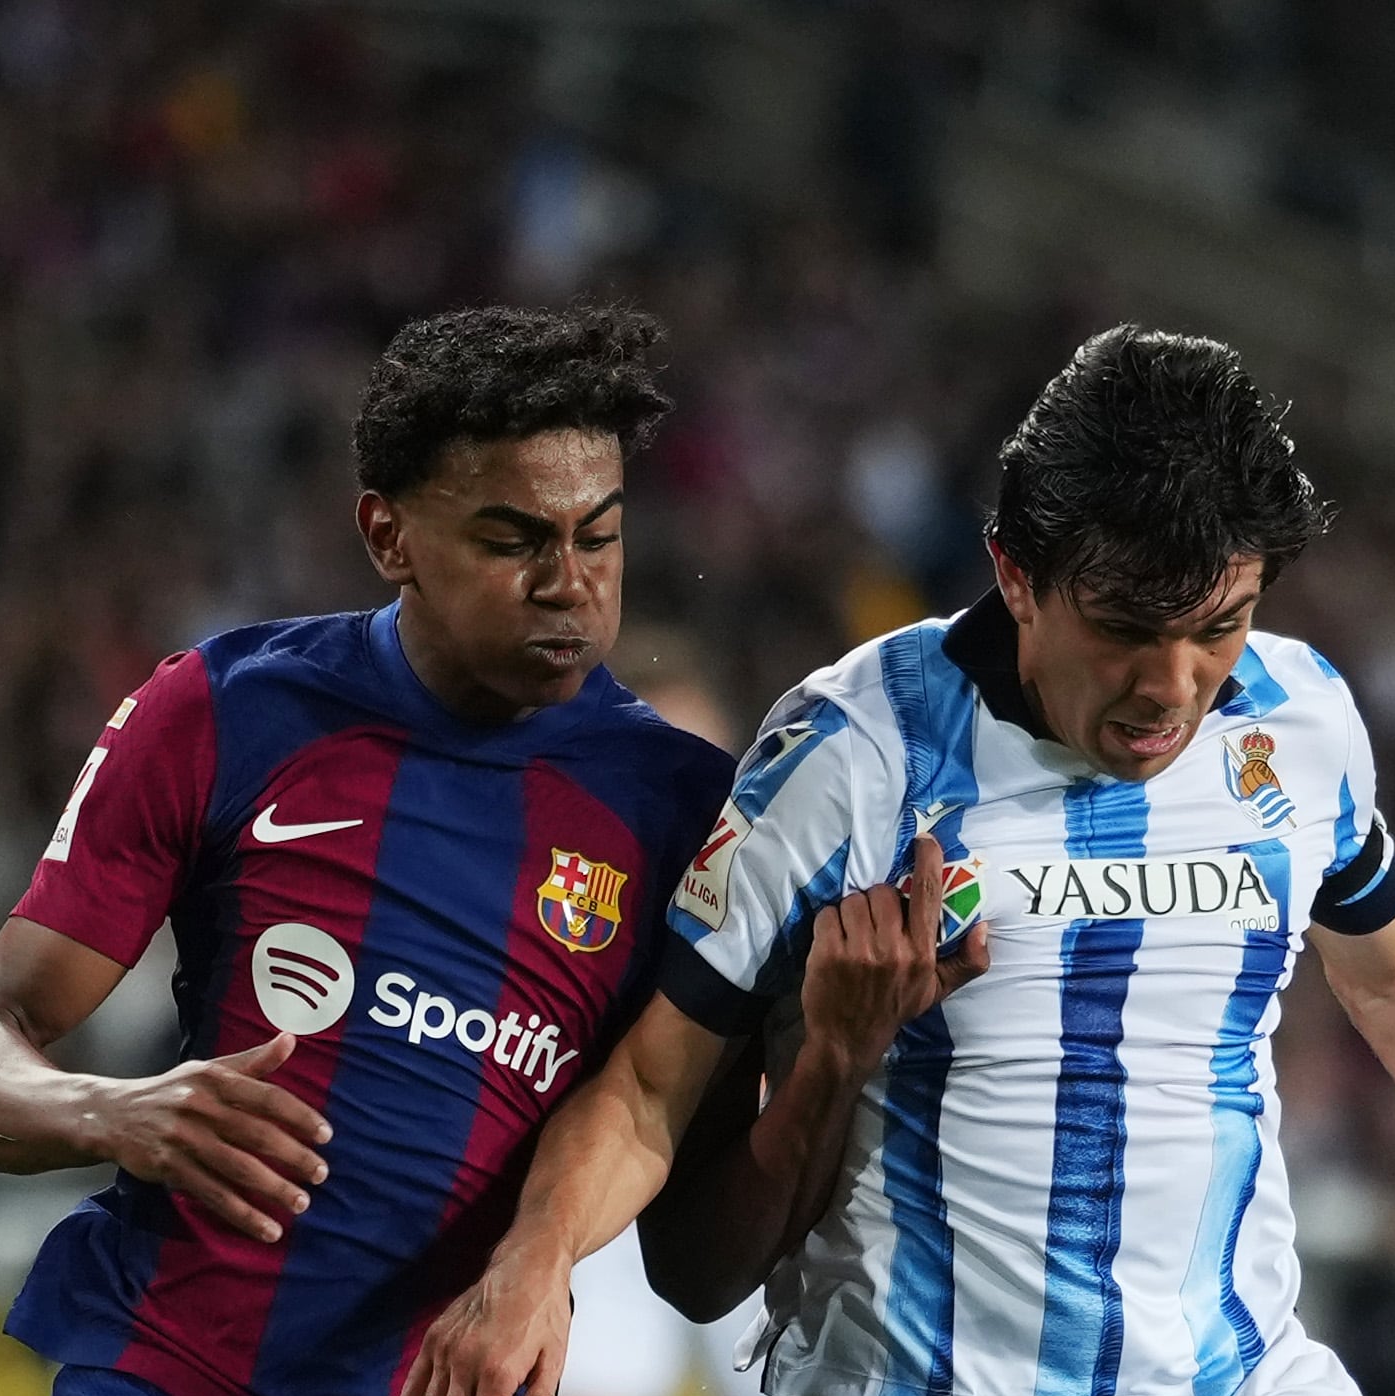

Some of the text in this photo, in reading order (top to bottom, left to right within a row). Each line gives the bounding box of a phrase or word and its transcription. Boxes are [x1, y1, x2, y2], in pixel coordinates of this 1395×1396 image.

[684, 874, 719, 911] LIGA
[1003, 857, 1274, 917] YASUDA
[368, 972, 579, 1093] Spotify
